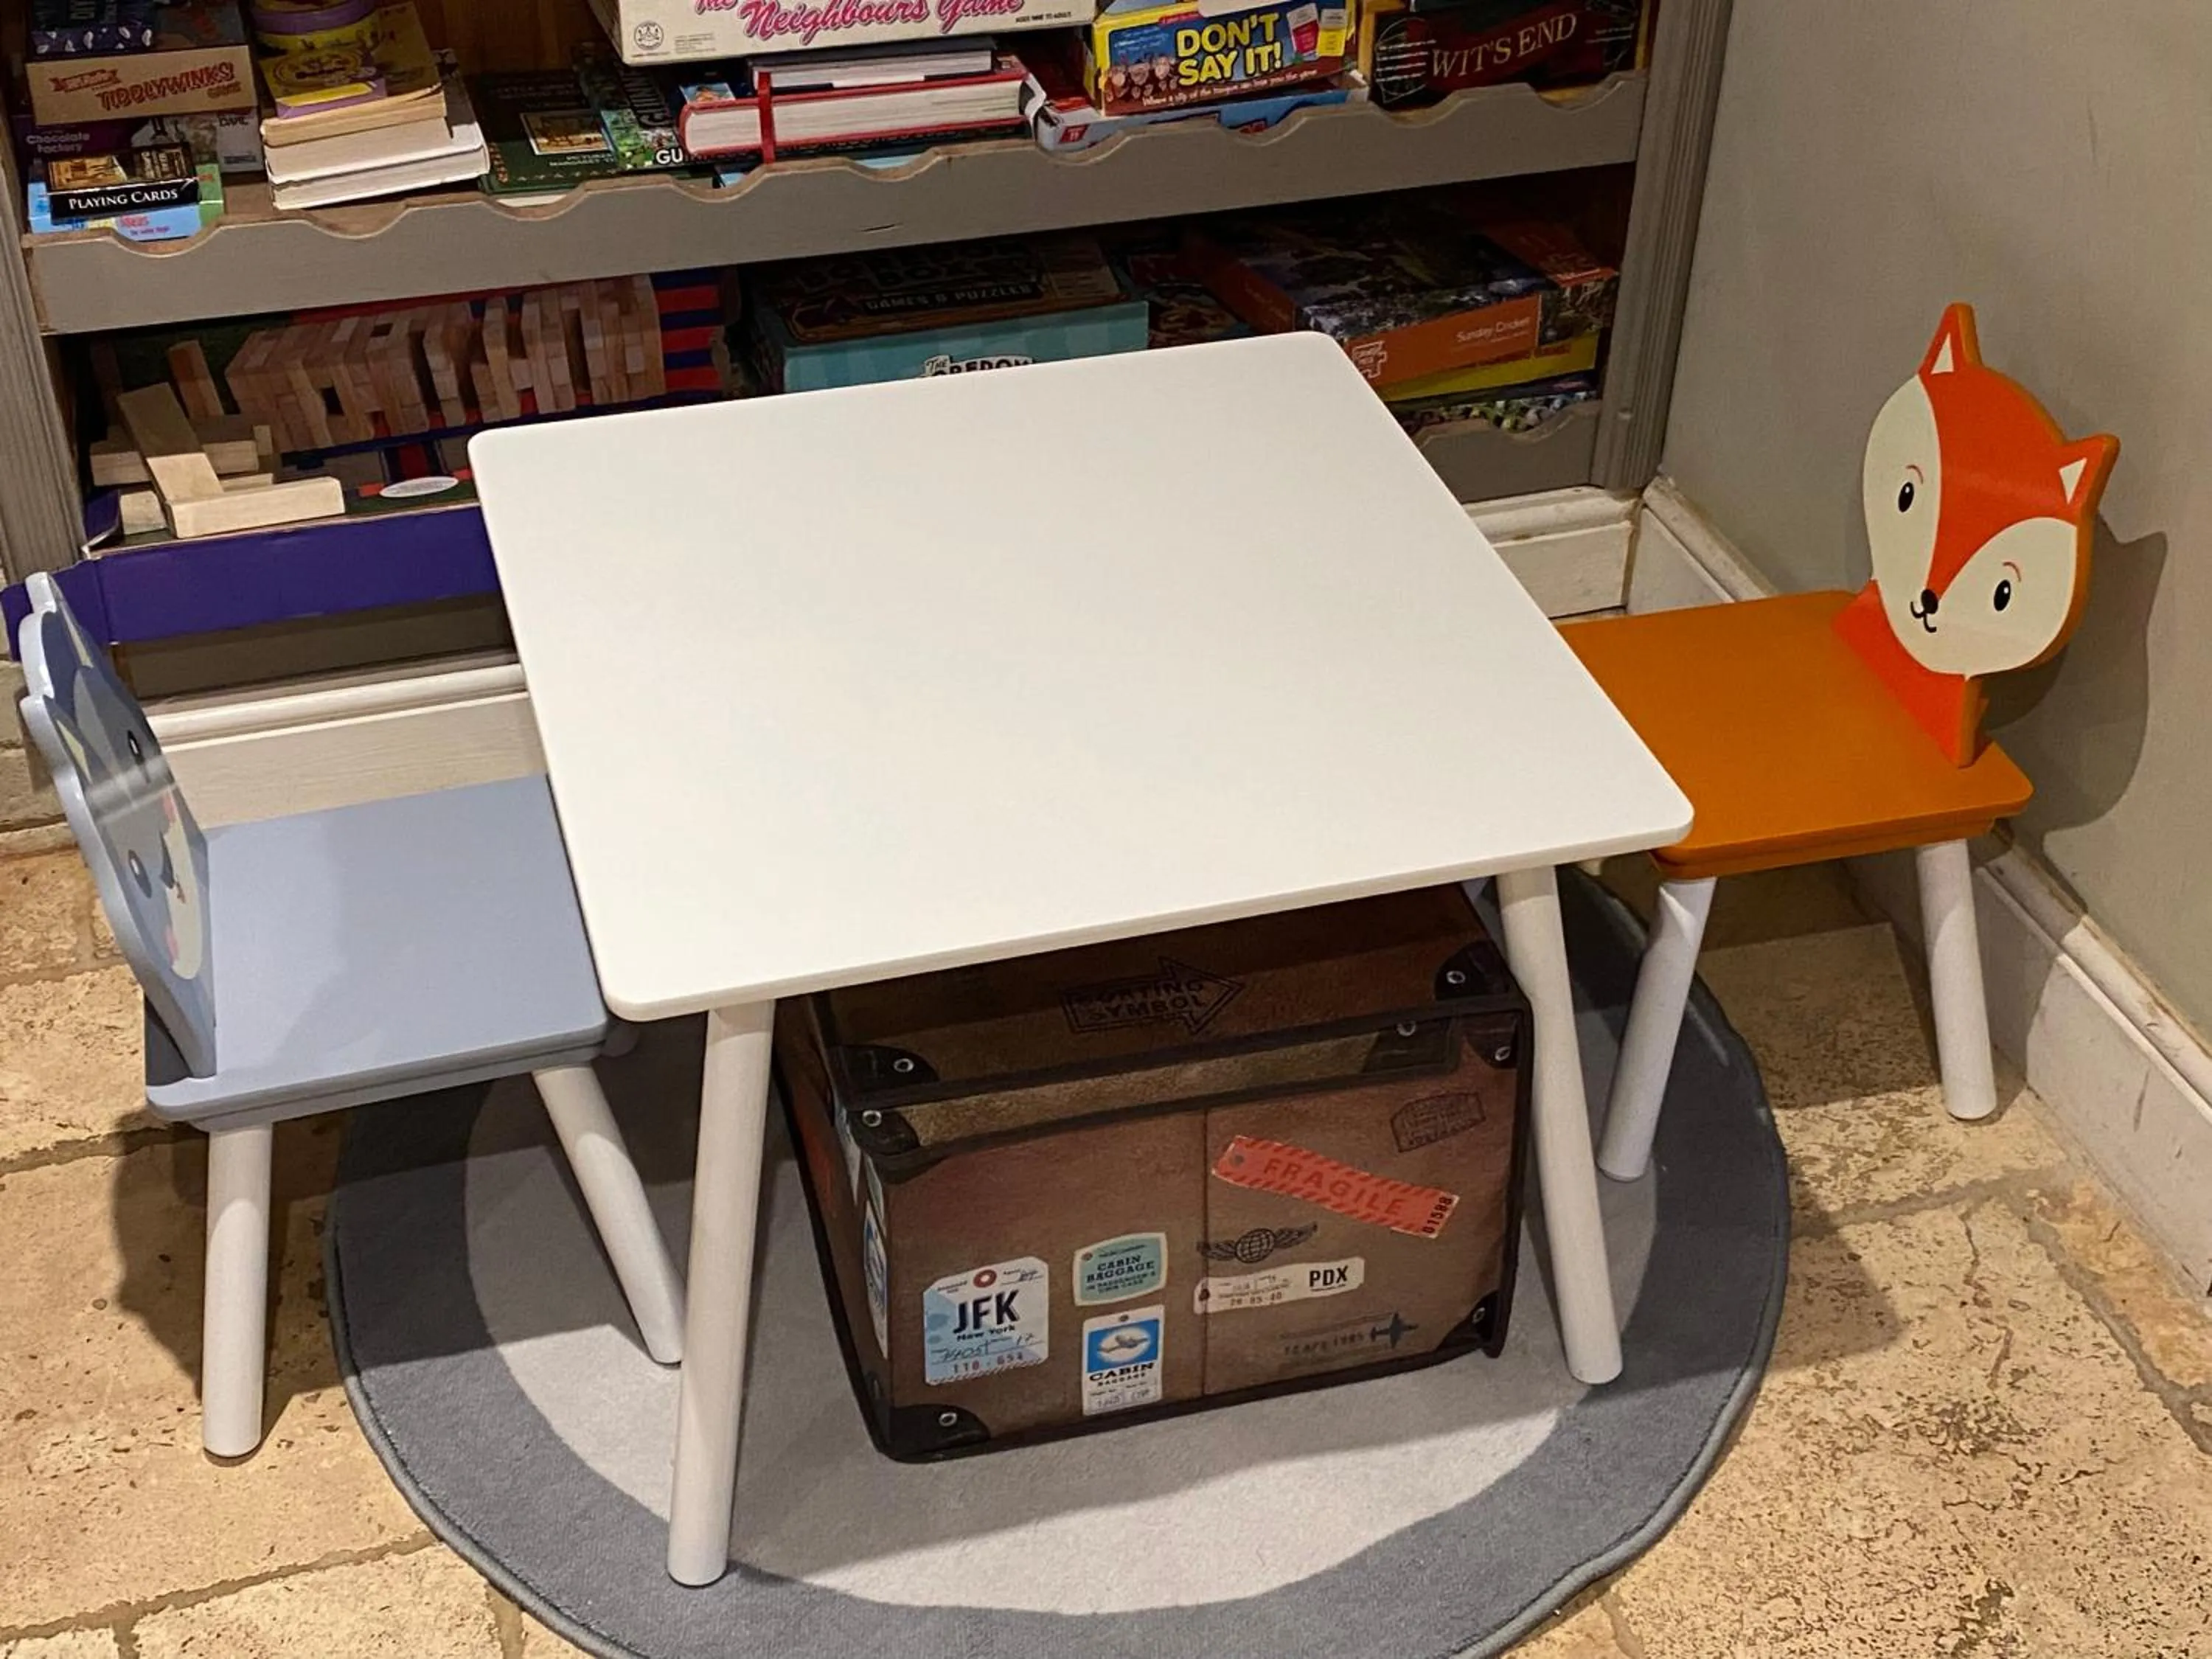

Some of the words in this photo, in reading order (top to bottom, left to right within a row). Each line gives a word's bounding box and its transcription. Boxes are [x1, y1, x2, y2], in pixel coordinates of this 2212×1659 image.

[739, 0, 930, 46] Neighbours
[1176, 12, 1279, 58] DON'T
[1432, 35, 1512, 77] WIT'S
[1517, 13, 1577, 58] END
[1178, 49, 1238, 86] SAY
[1245, 41, 1282, 76] IT!
[68, 191, 128, 210] PLAYING
[131, 187, 178, 204] CARDS
[1264, 1158, 1406, 1215] FRAGILE
[1087, 1261, 1155, 1283] BAGGAGE
[1097, 1255, 1141, 1271] CABIN
[1310, 1265, 1349, 1287] PDX
[953, 1289, 1020, 1334] JFK
[1090, 1363, 1154, 1381] CABIN
